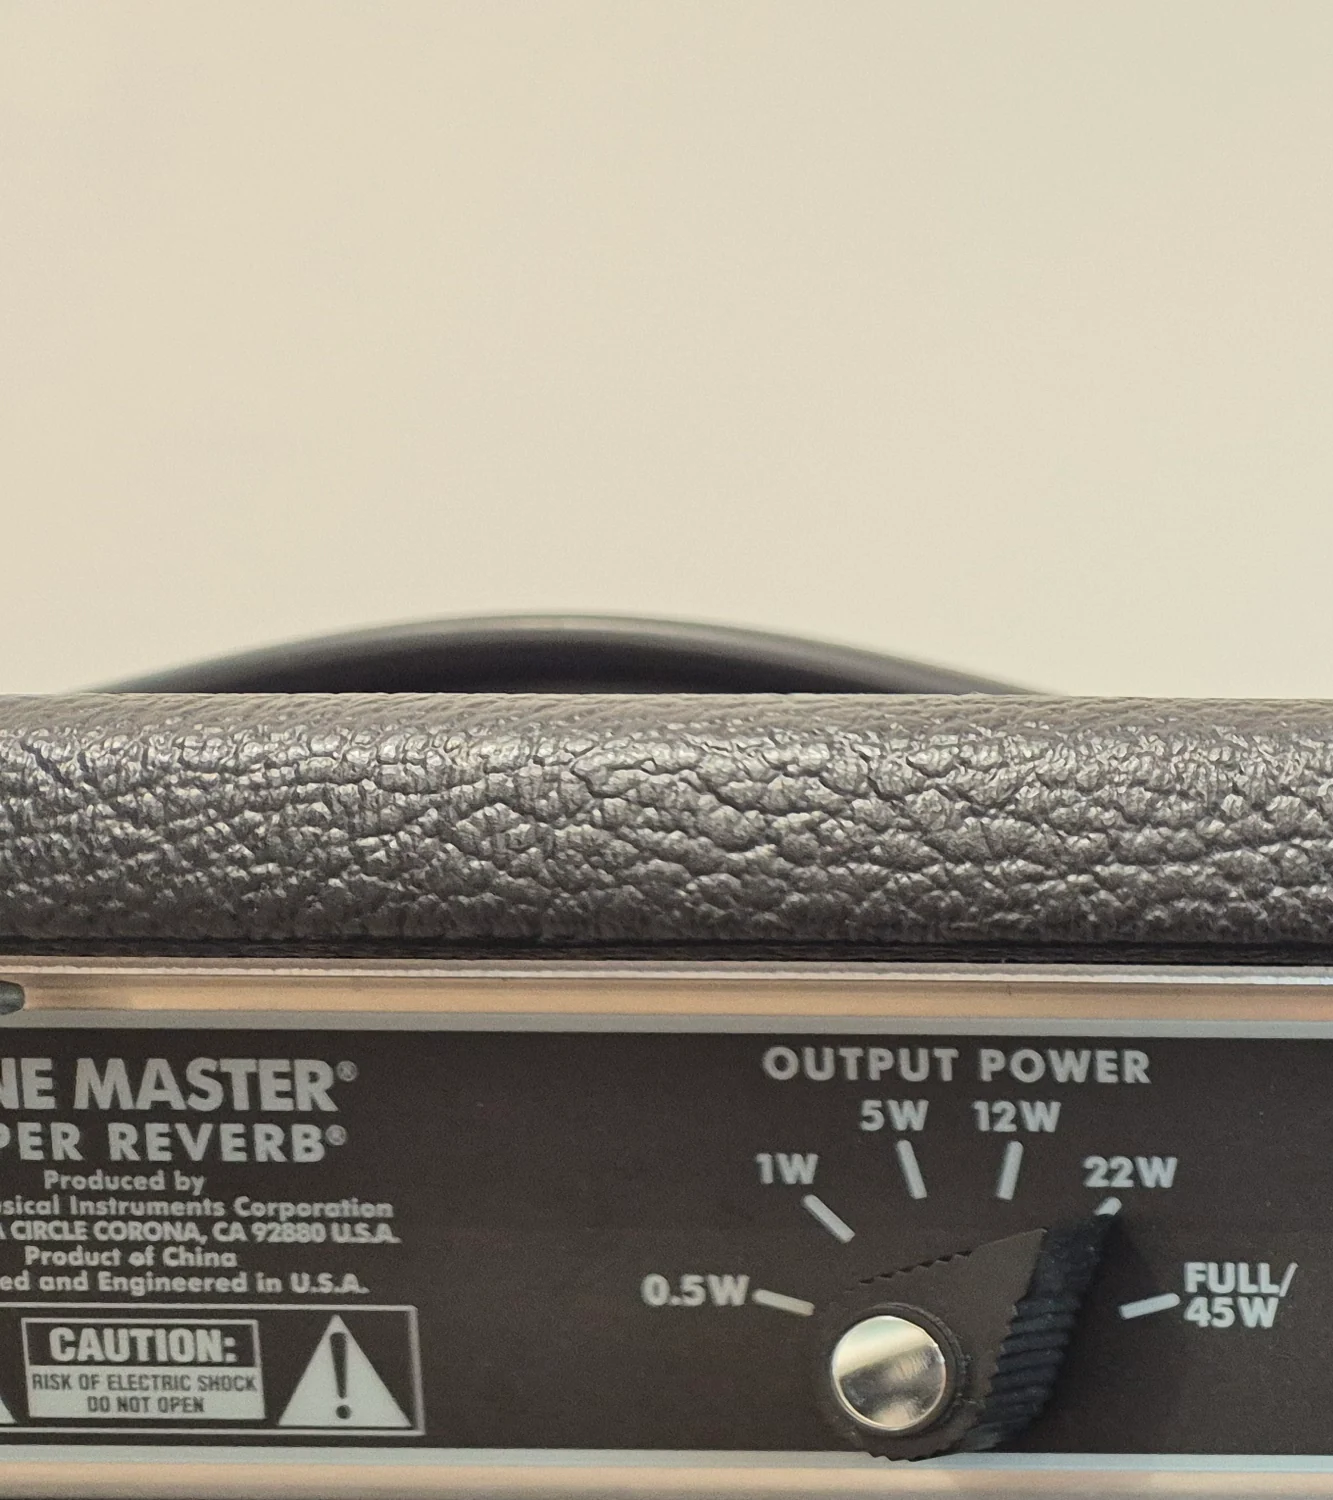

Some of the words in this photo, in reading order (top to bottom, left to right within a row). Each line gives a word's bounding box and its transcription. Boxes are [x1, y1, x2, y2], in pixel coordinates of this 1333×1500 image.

[762, 1046, 959, 1082] OUTPUT
[979, 1048, 1151, 1084] POWER
[860, 1099, 929, 1132] 5W
[973, 1100, 1062, 1133] 12W
[43, 1168, 166, 1191] Produced
[173, 1169, 207, 1197] by
[755, 1152, 819, 1185] 1W
[1083, 1155, 1178, 1189] 22W
[0, 1193, 61, 1216] sical
[69, 1194, 226, 1217] Instruments
[232, 1195, 394, 1221] Corporation
[10, 1219, 89, 1241] CIRCLE
[92, 1220, 208, 1245] CORONA,
[211, 1220, 249, 1243] CA
[24, 1244, 122, 1267] Product
[127, 1244, 156, 1268] of
[162, 1244, 238, 1268] China
[38, 1269, 90, 1292] and
[97, 1270, 249, 1297] Engineered
[255, 1271, 284, 1294] in
[290, 1271, 370, 1294] U.S.A.
[641, 1273, 750, 1307] 0.5W
[1183, 1295, 1280, 1329] 45W
[49, 1326, 237, 1363] CAUTION:
[32, 1374, 72, 1391] RISK
[78, 1374, 102, 1391] OF
[107, 1374, 192, 1392] ELECTRIC
[197, 1375, 257, 1392] SHOCK
[87, 1397, 111, 1414] DO
[117, 1397, 151, 1414] NOT
[157, 1397, 205, 1414] OPEN
